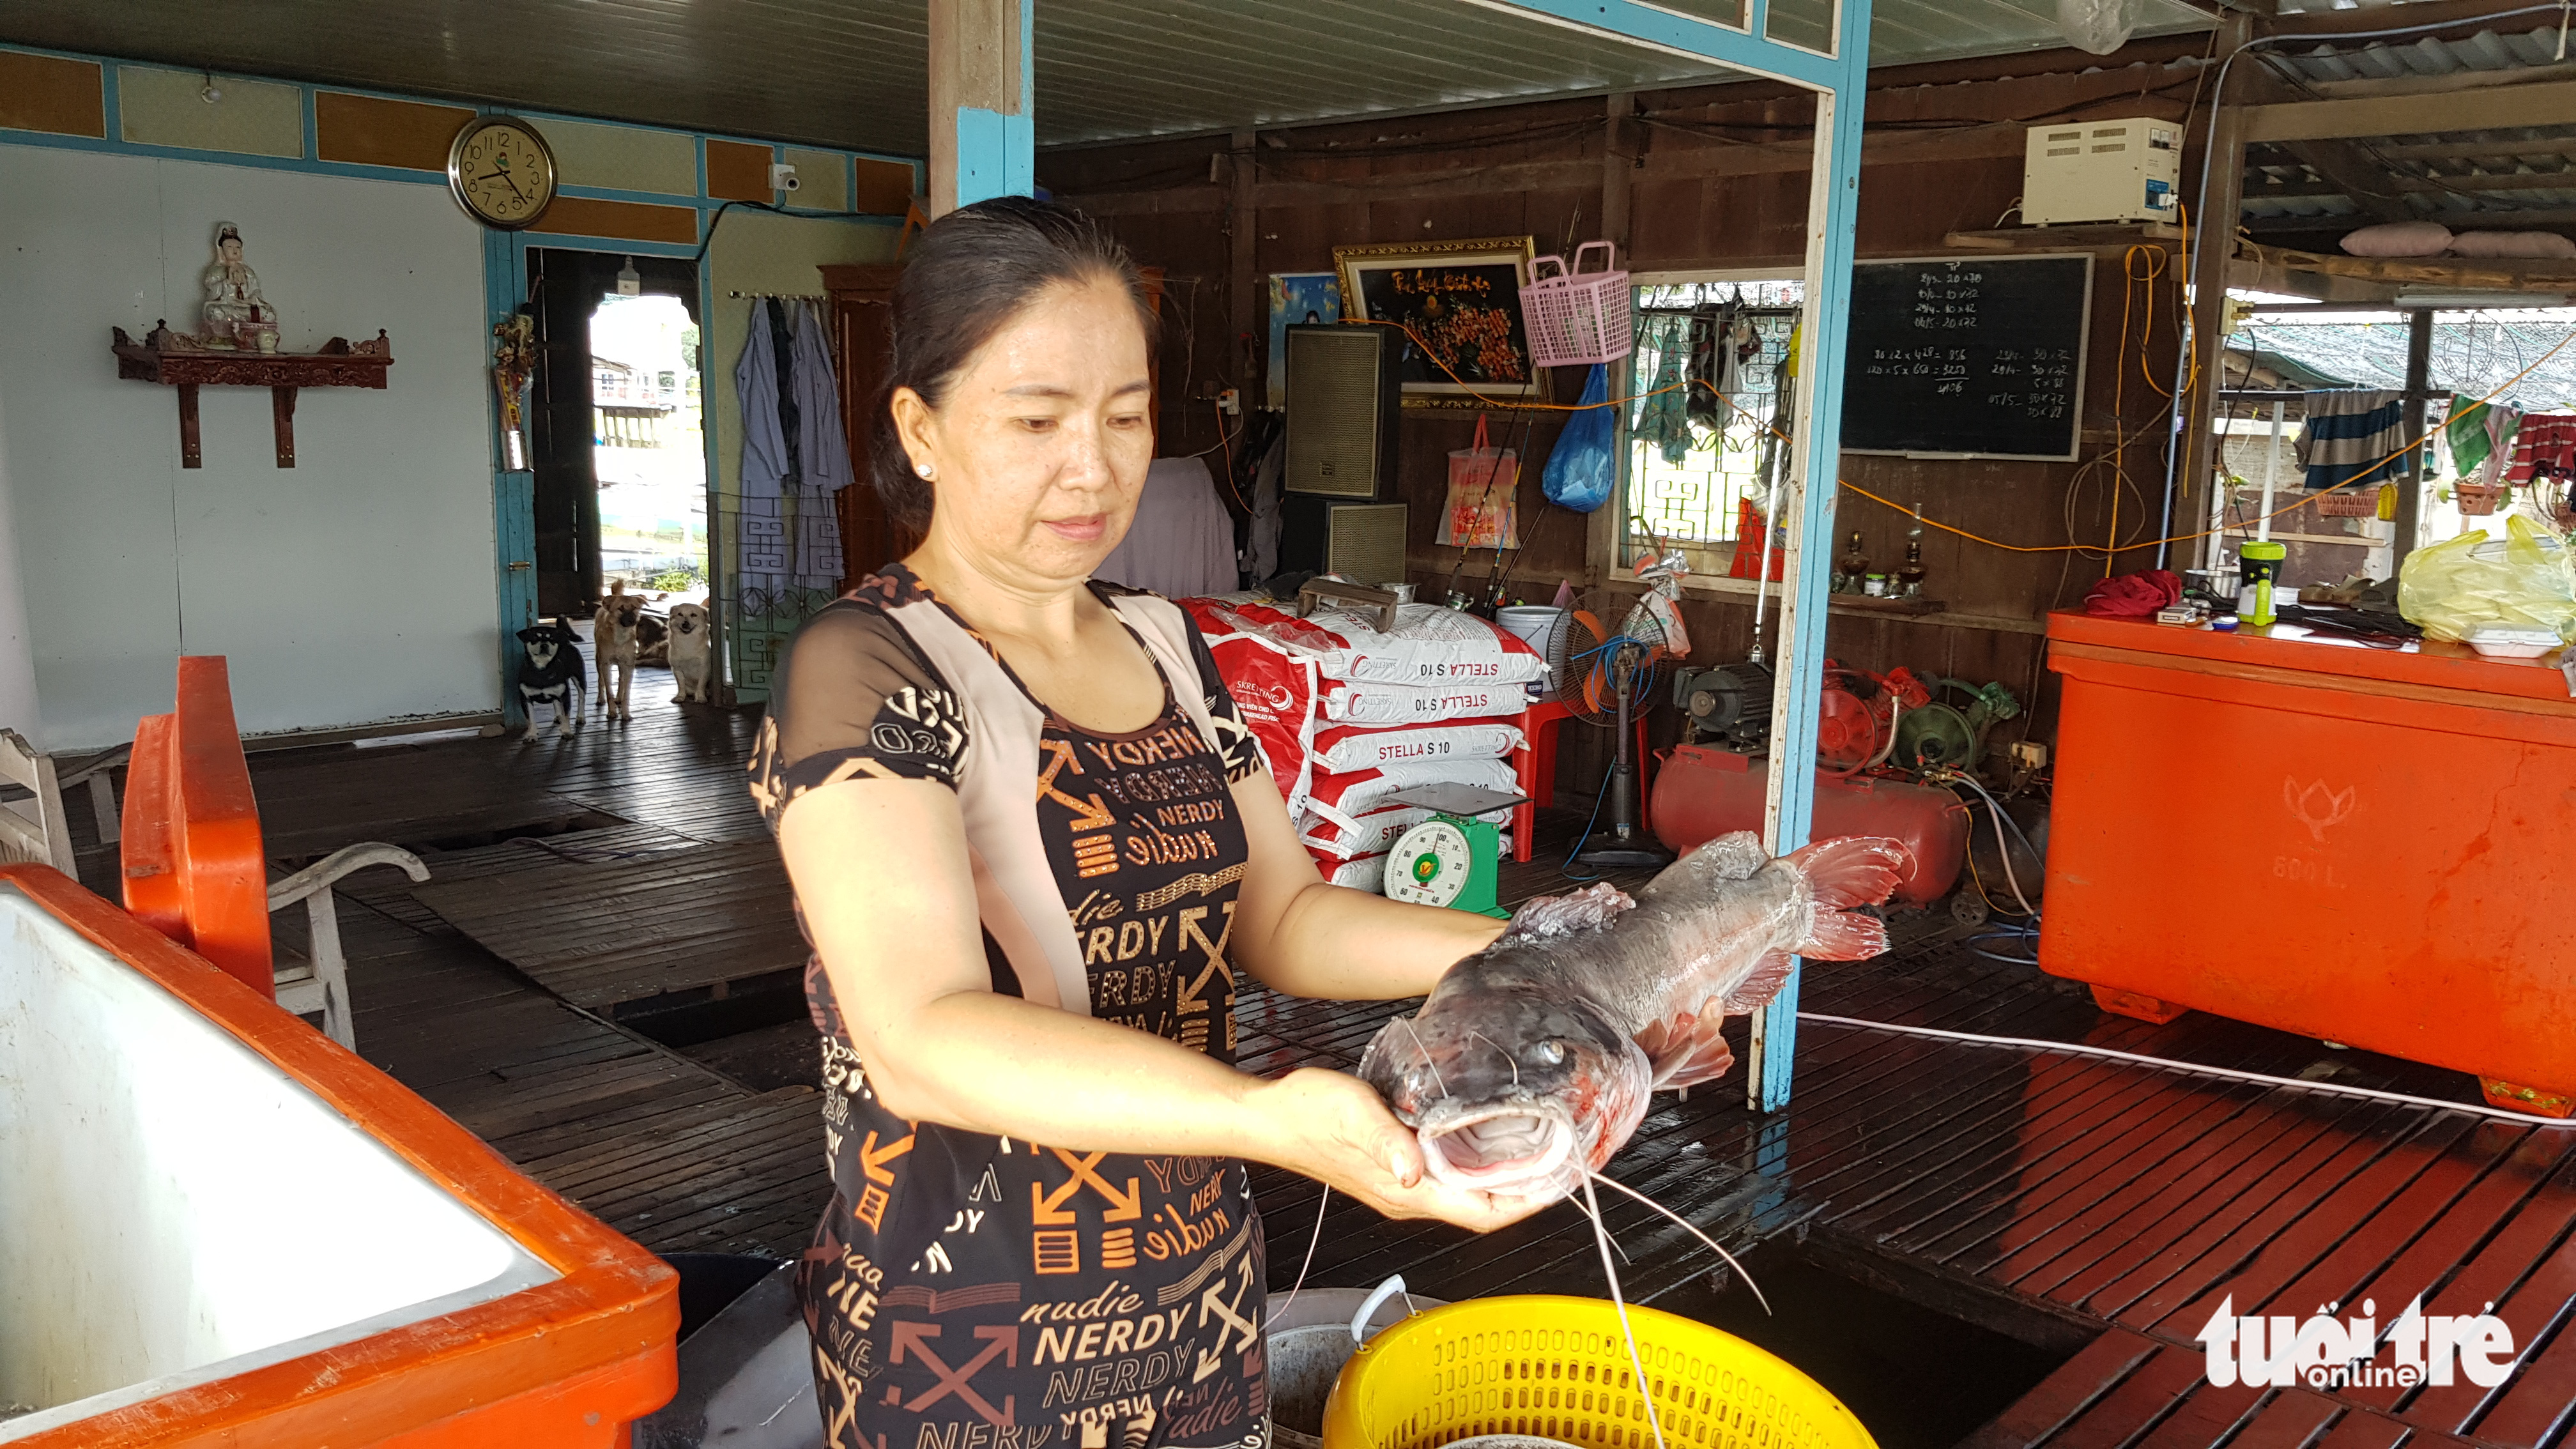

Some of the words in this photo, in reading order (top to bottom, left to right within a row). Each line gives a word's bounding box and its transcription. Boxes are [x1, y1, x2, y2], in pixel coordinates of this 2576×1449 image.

[484, 135, 493, 151] 11
[498, 131, 510, 147] 12
[470, 144, 482, 160] 10
[526, 154, 535, 168] 2
[464, 162, 475, 175] 9
[530, 171, 540, 185] 3
[468, 179, 478, 192] 8
[482, 192, 491, 206] 7
[526, 188, 535, 201] 4
[496, 201, 507, 215] 6
[512, 197, 523, 211] 5
[1420, 663, 1433, 676] 10
[1436, 663, 1445, 675] S
[1450, 663, 1499, 676] STELLA
[1415, 698, 1428, 711] 10
[1430, 699, 1437, 710] S
[1440, 694, 1488, 710] STELLA
[1379, 743, 1424, 760] STELLA
[1427, 742, 1435, 755] S
[1438, 741, 1450, 755] 10
[1155, 799, 1225, 827] NERDY
[1431, 896, 1439, 904] 40
[1020, 1280, 1145, 1325] nudie
[1032, 1301, 1193, 1366] NERDY
[1042, 1337, 1196, 1409] NERDY
